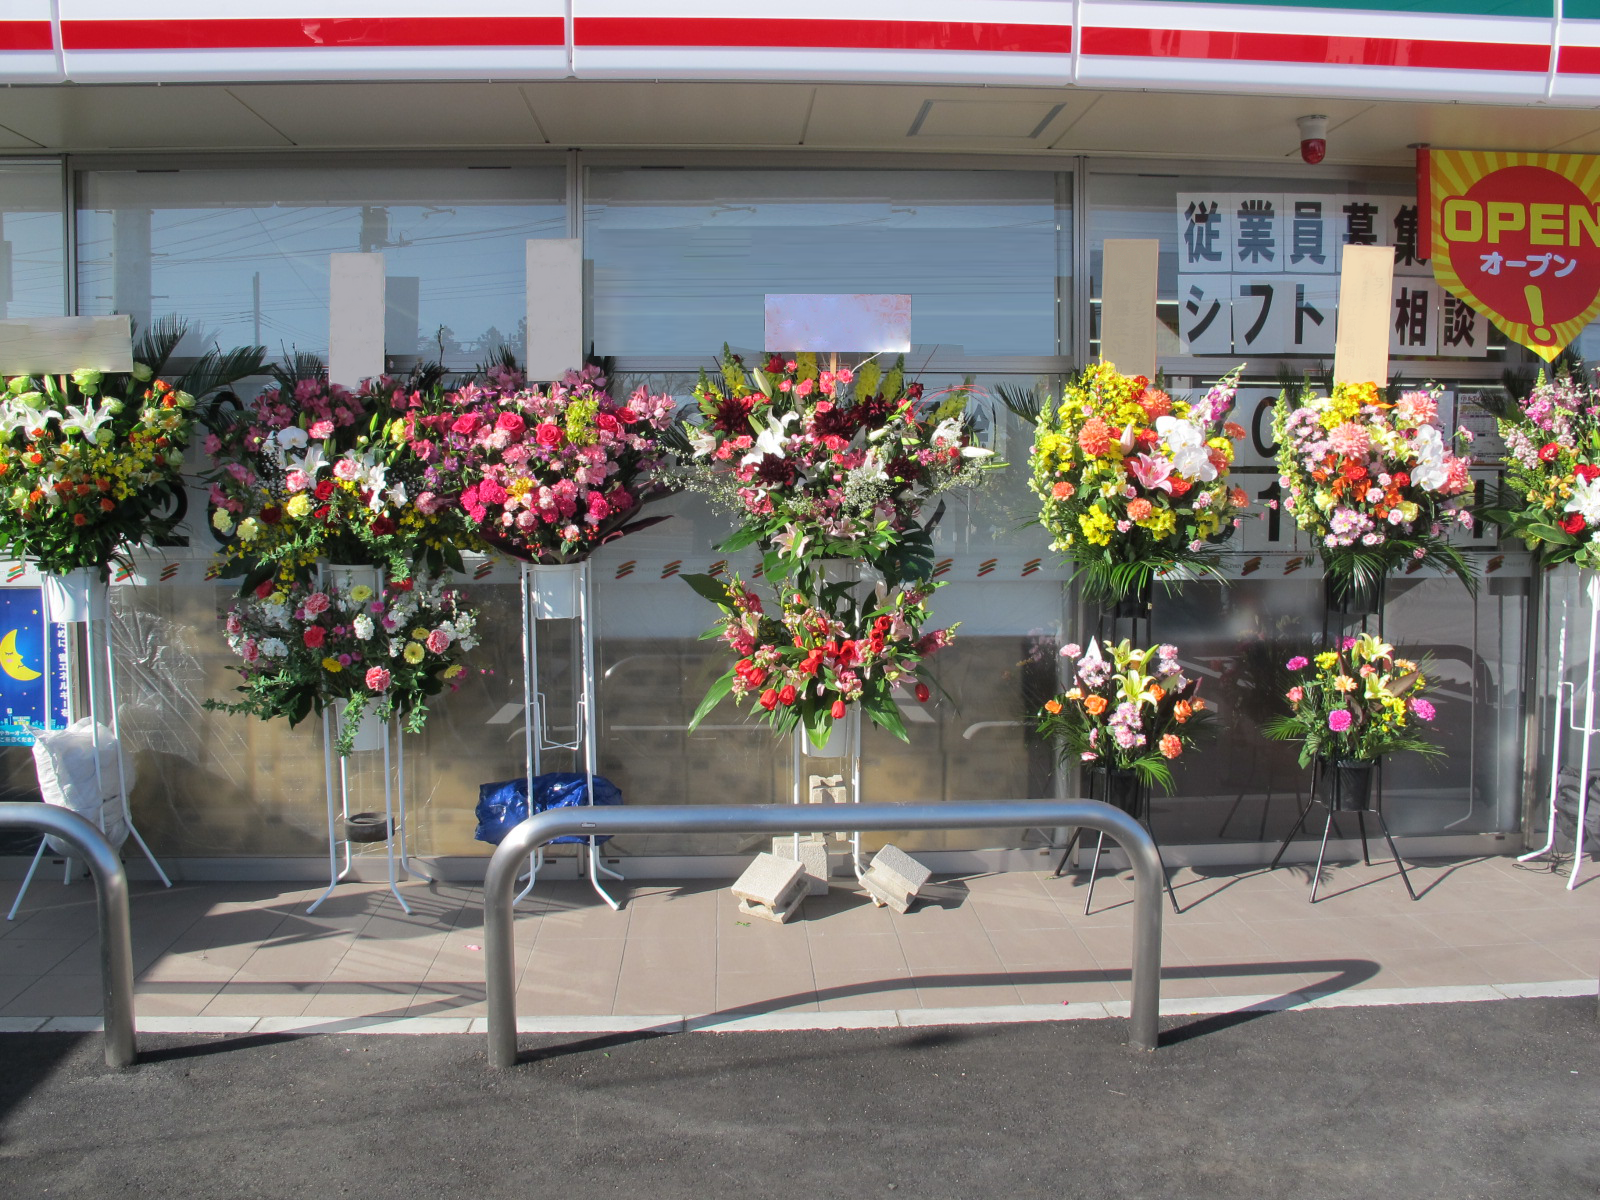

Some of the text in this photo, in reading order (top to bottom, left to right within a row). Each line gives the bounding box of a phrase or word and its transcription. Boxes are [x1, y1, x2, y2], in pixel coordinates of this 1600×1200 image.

[1443, 199, 1600, 248] OPEN
[1480, 252, 1577, 278] オープン
